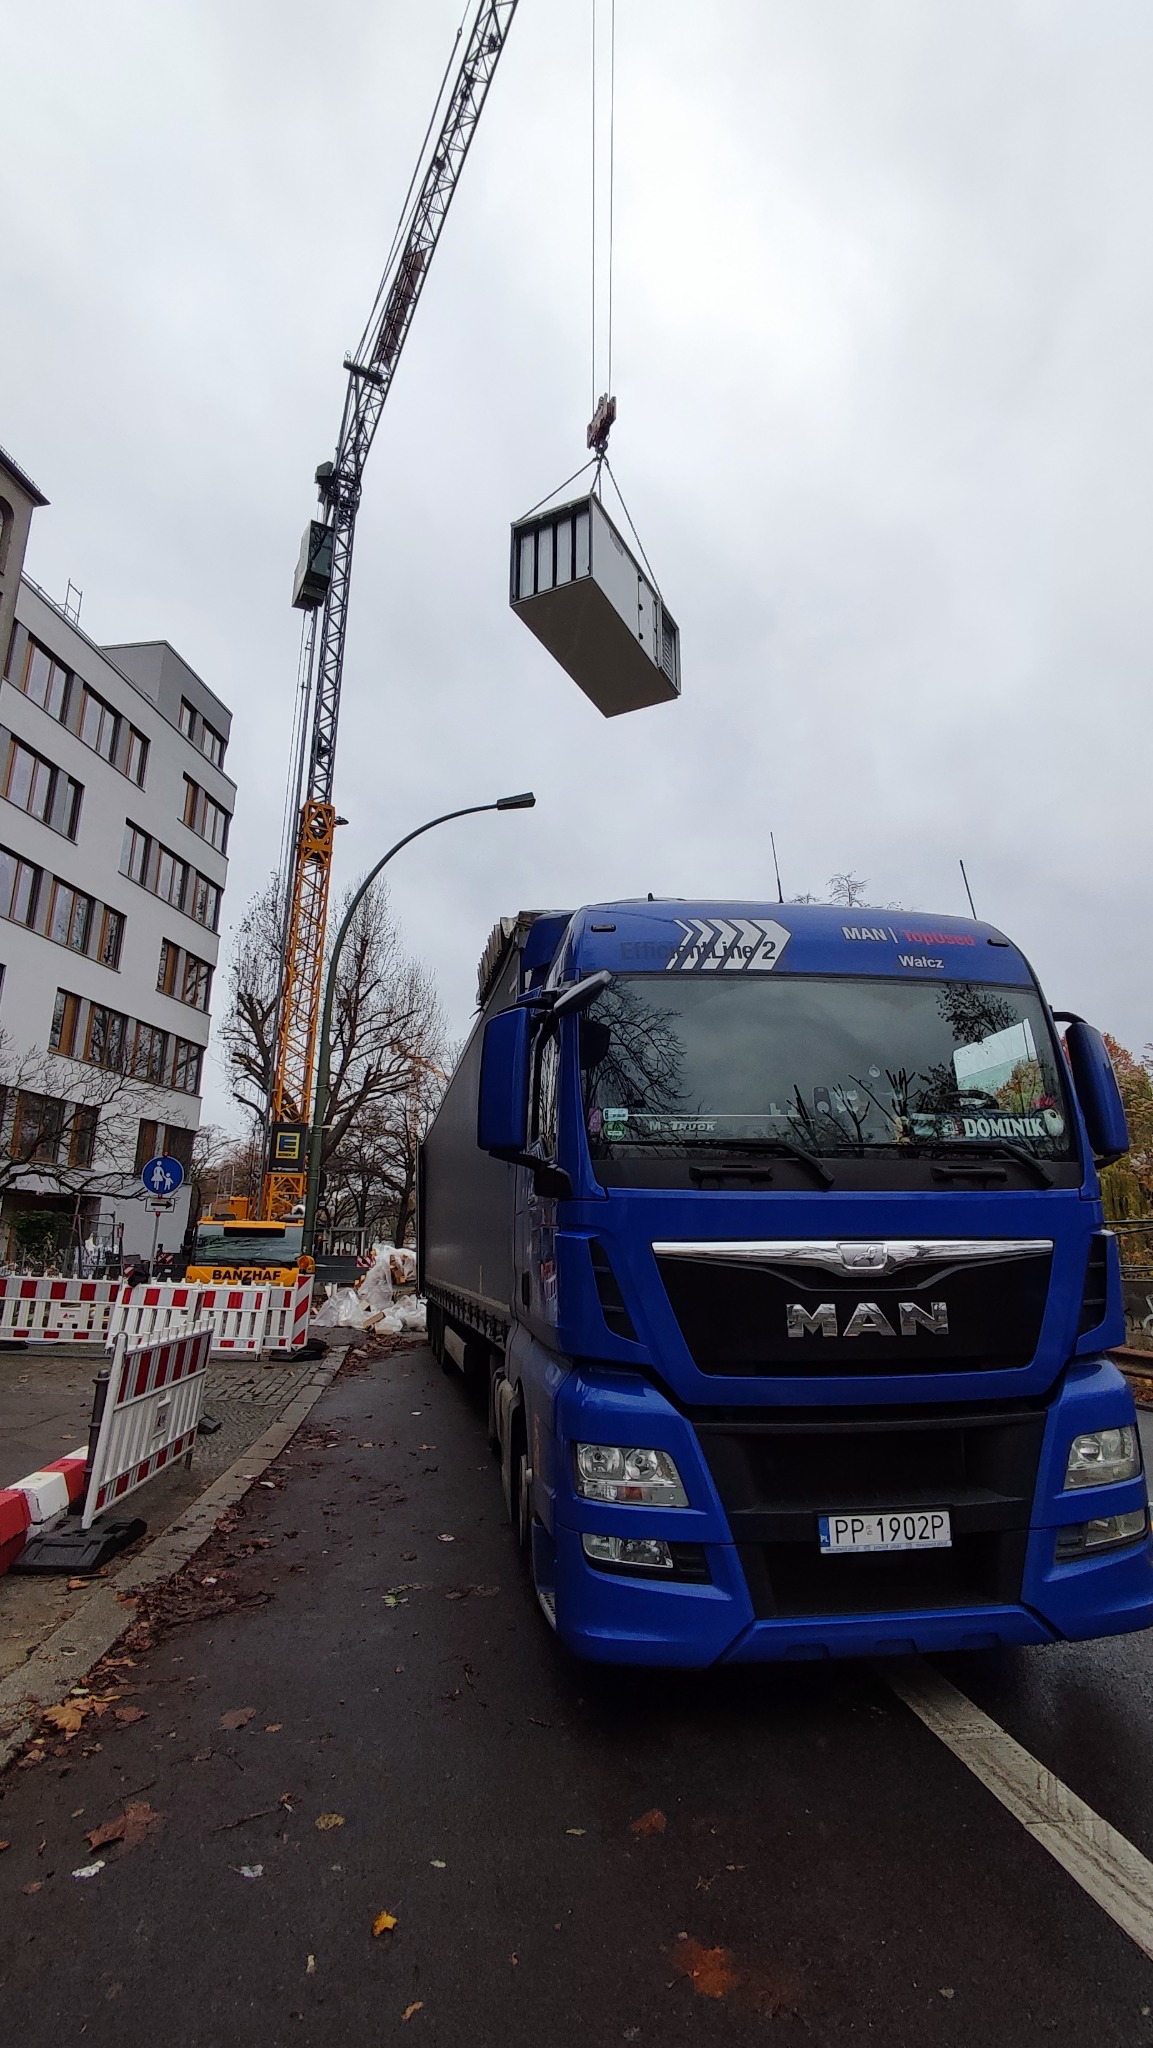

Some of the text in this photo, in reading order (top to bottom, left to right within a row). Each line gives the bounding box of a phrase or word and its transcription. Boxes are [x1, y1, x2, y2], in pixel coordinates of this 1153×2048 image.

[841, 926, 976, 946] MAN TopUsed
[761, 940, 777, 960] 2
[898, 954, 945, 969] Wałcz
[962, 1117, 1047, 1138] DOMINIK
[212, 1270, 281, 1280] BANZHAF
[786, 1302, 949, 1337] MAN
[820, 1535, 830, 1543] PL
[835, 1514, 944, 1544] PP 1902P
